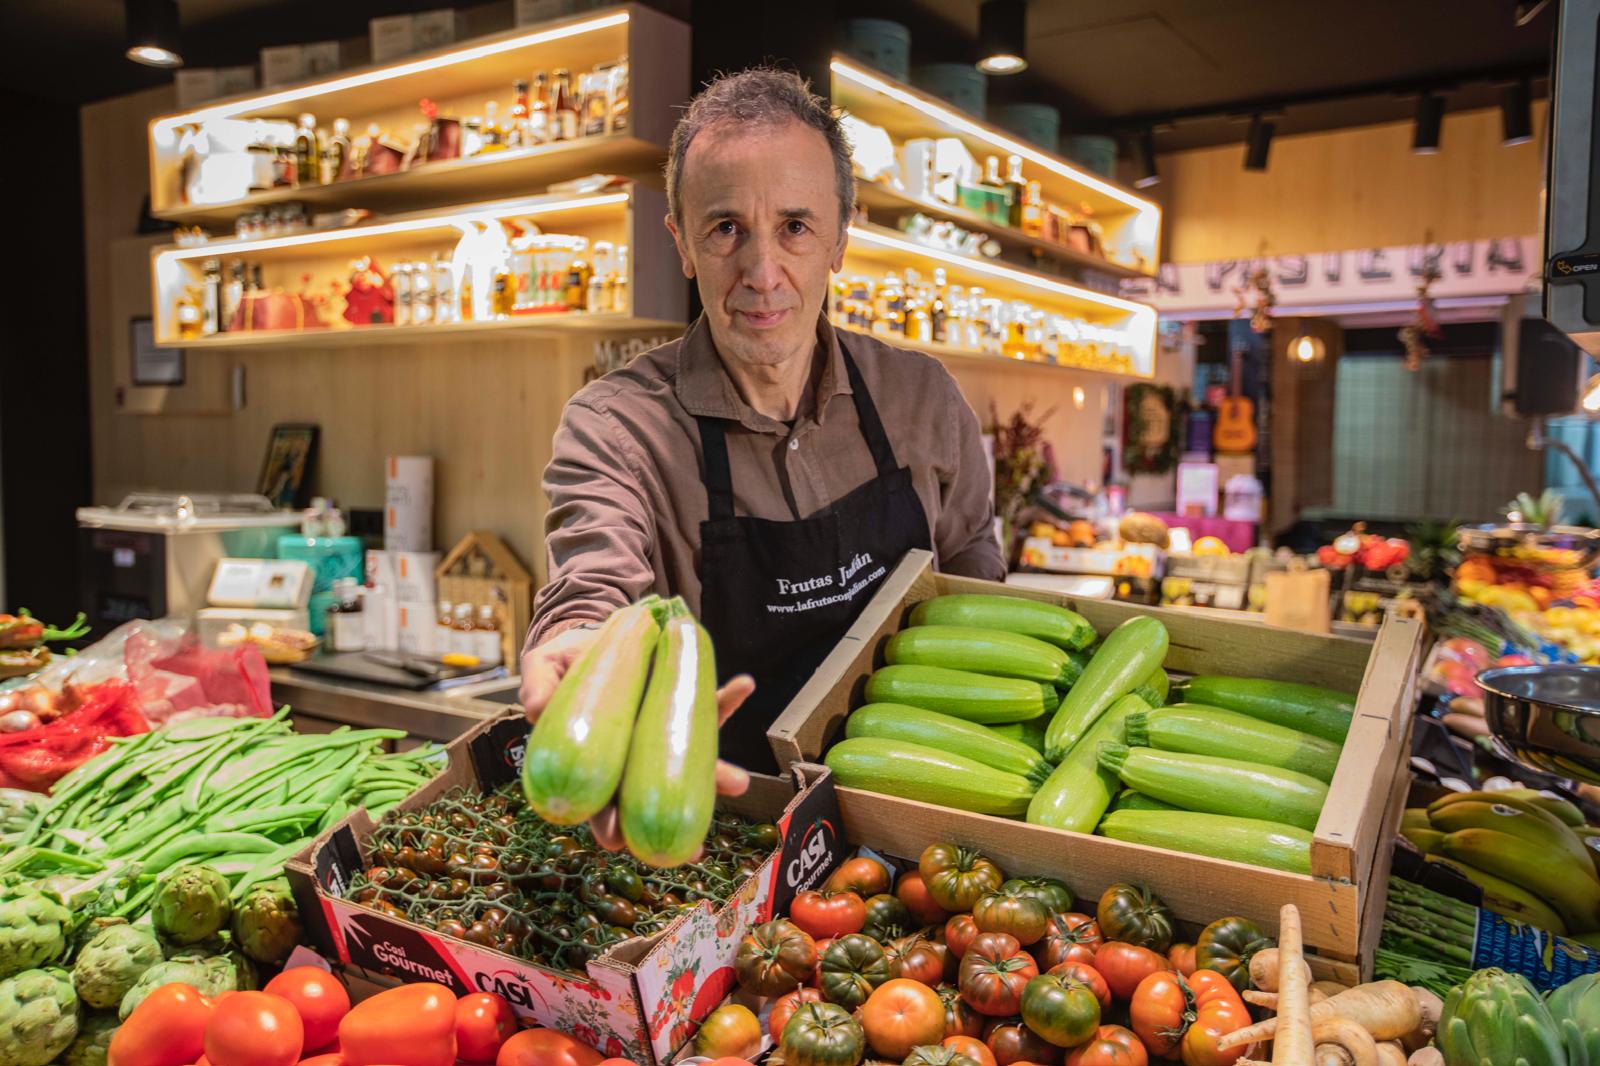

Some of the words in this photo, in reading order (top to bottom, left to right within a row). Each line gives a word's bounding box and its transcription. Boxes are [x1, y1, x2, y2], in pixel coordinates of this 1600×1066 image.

[1572, 264, 1598, 272] OPEN
[776, 574, 834, 595] Frutas
[787, 828, 827, 888] CASI
[795, 850, 833, 896] Gourmet
[372, 943, 453, 987] Gourmet
[383, 940, 407, 958] Casi
[474, 970, 535, 1012] CASI
